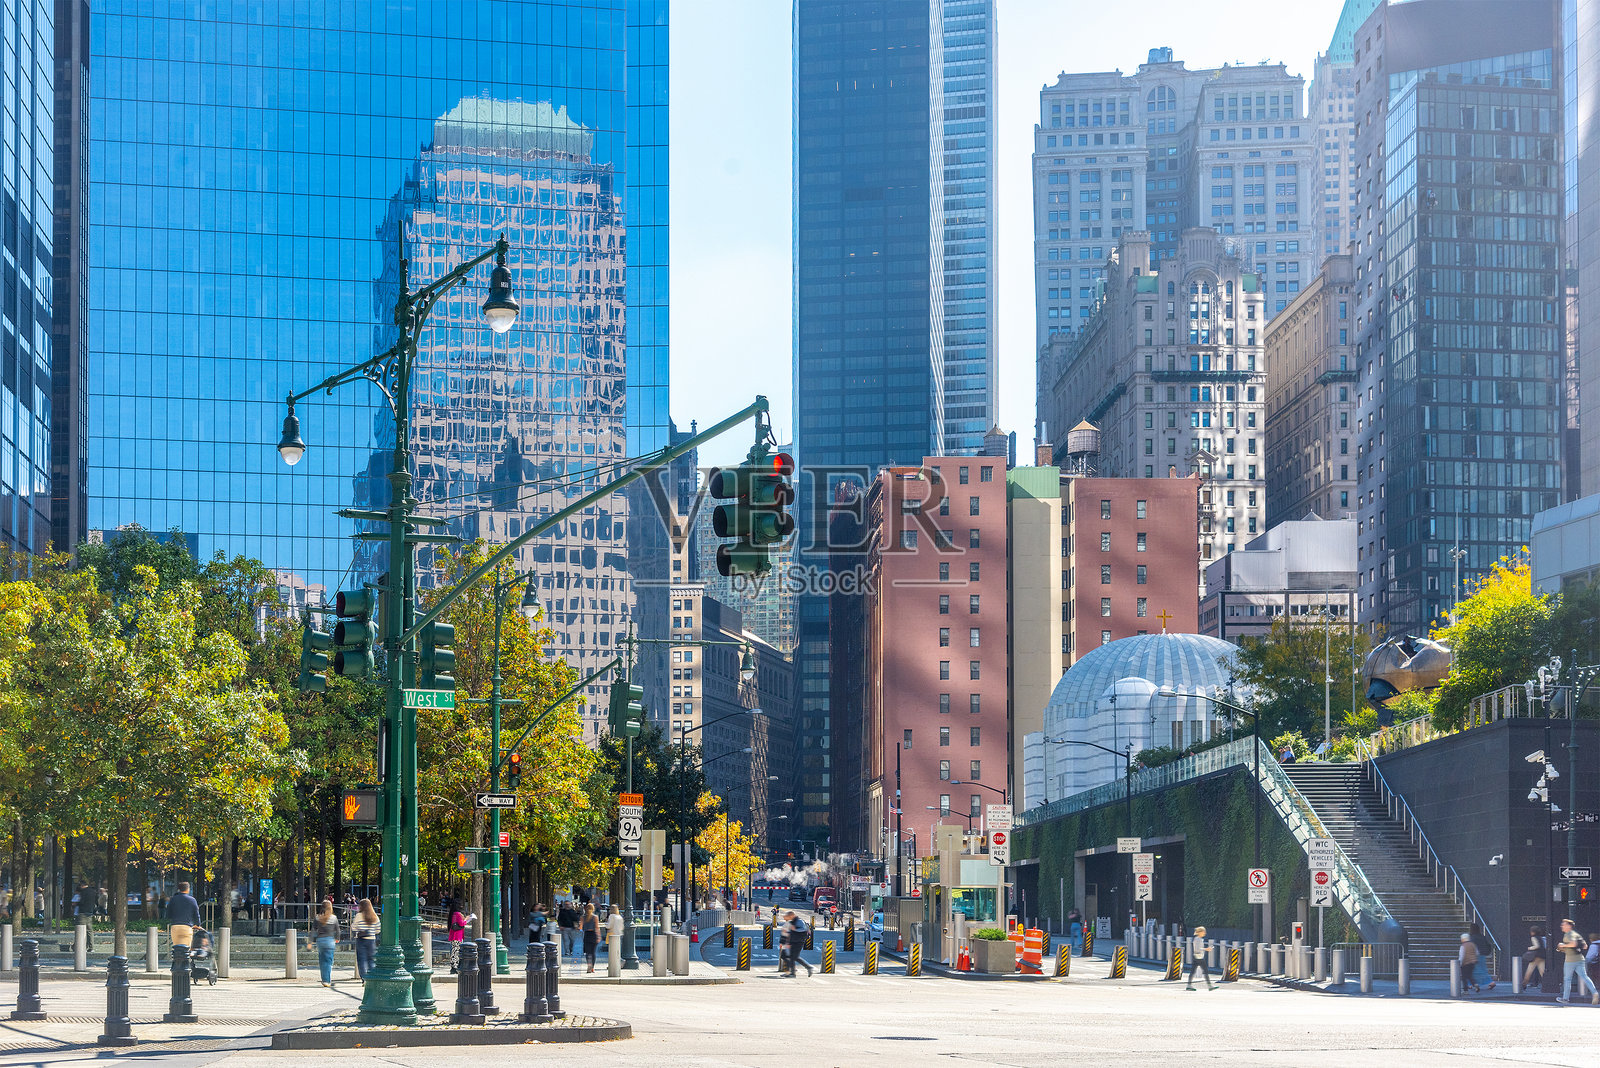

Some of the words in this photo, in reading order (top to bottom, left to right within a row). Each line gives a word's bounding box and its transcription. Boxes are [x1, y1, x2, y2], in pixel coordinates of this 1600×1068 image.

[405, 691, 437, 707] West
[444, 692, 452, 702] St
[621, 795, 642, 803] DETOUR
[621, 807, 641, 815] SOUTH
[623, 822, 638, 837] 9A
